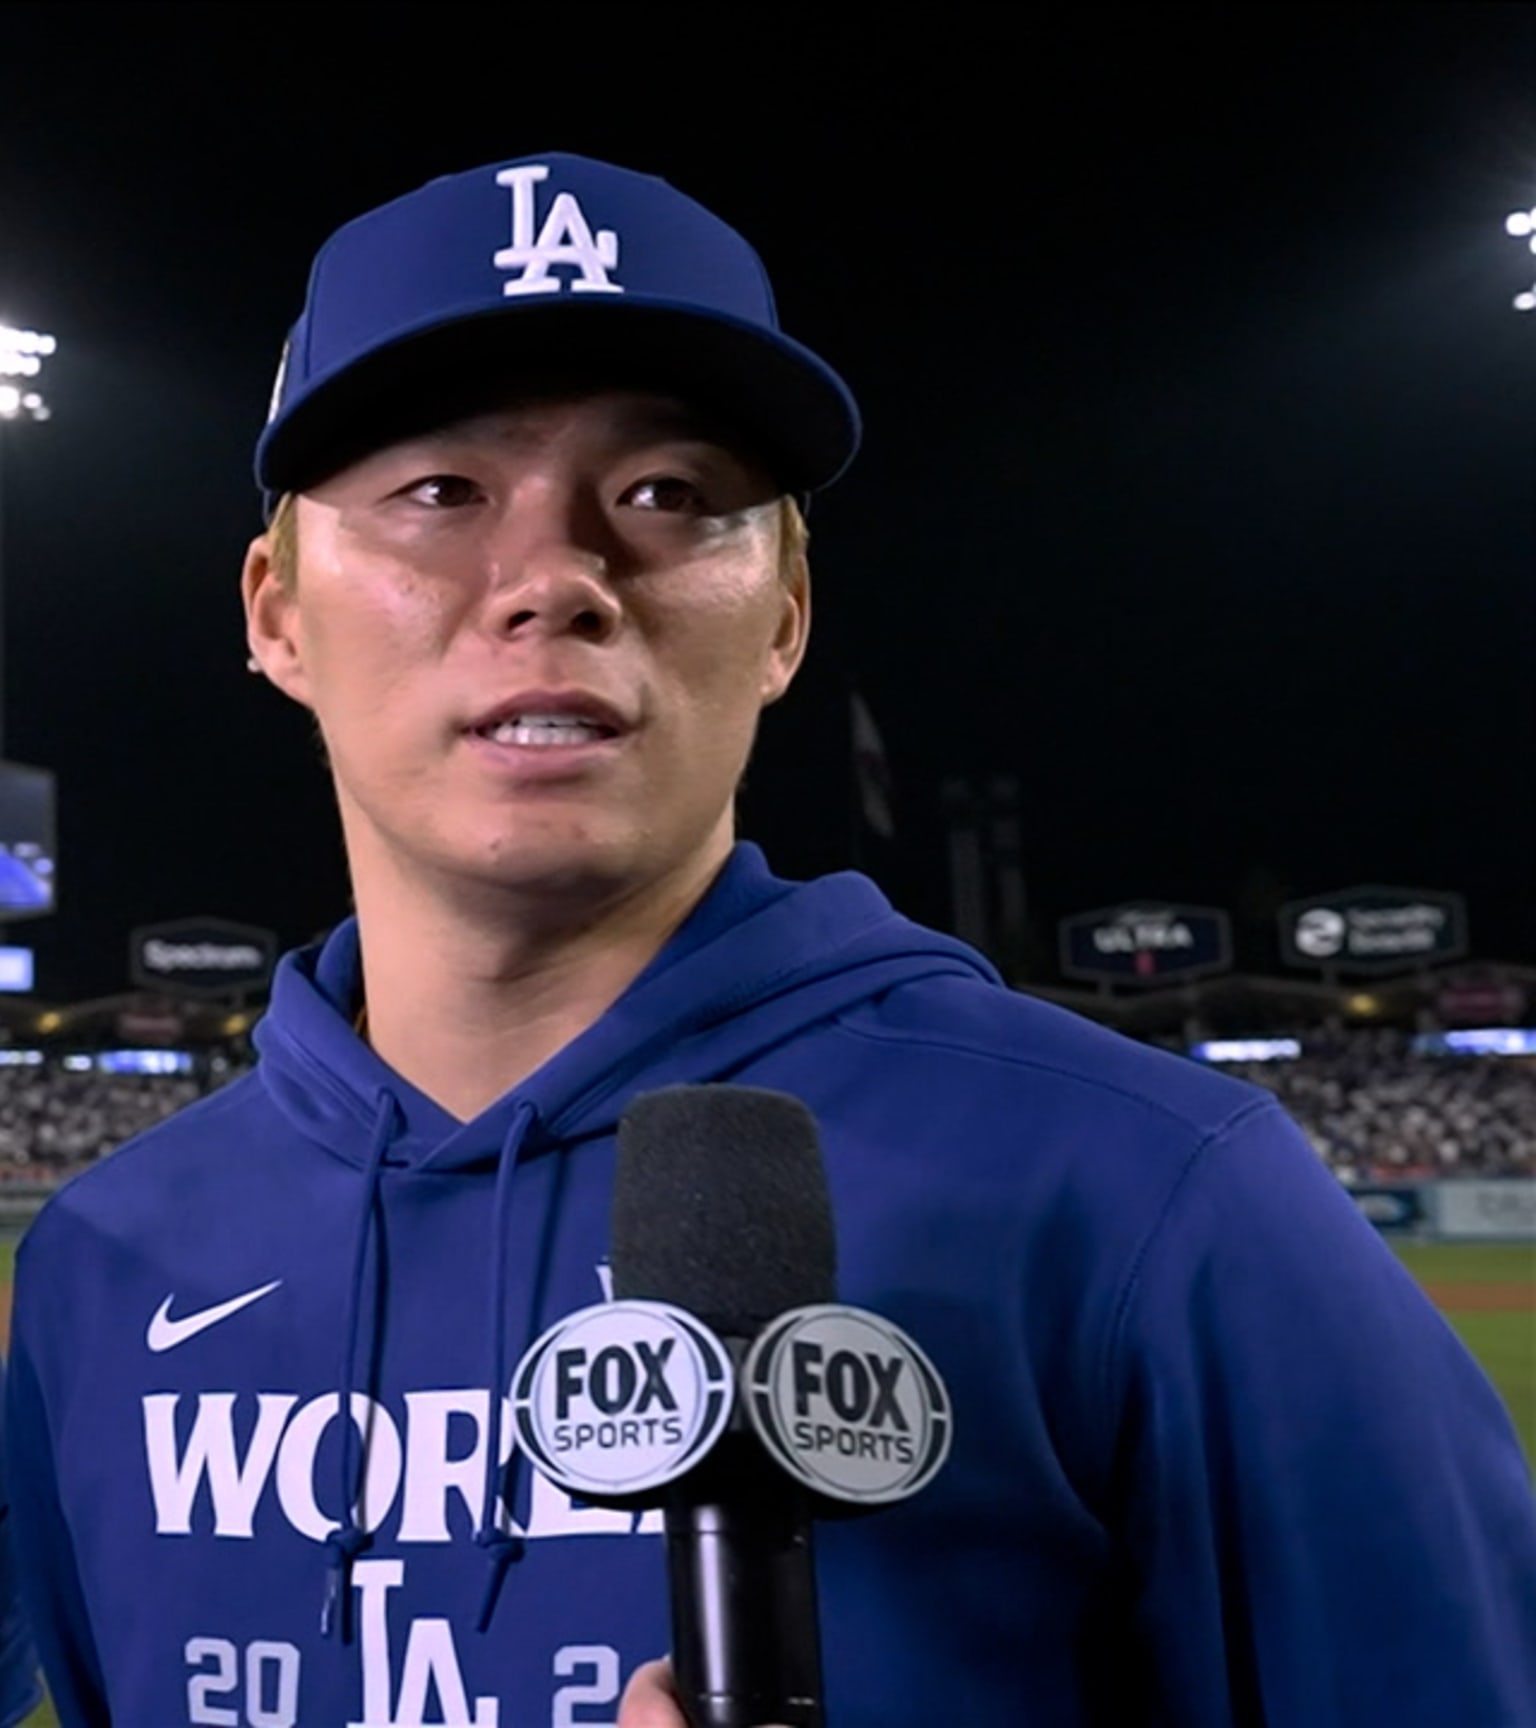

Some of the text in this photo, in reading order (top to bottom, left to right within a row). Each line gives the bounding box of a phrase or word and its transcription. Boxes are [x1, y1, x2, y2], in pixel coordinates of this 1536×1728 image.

[494, 165, 625, 296] LA
[143, 939, 262, 971] Spectrum
[555, 1337, 679, 1420] FOX
[791, 1340, 911, 1433] FOX
[142, 1389, 665, 1543] WOR
[553, 1416, 683, 1452] SPORTS
[793, 1421, 914, 1465] SPORTS
[184, 1559, 621, 1728] 20 LA 2
